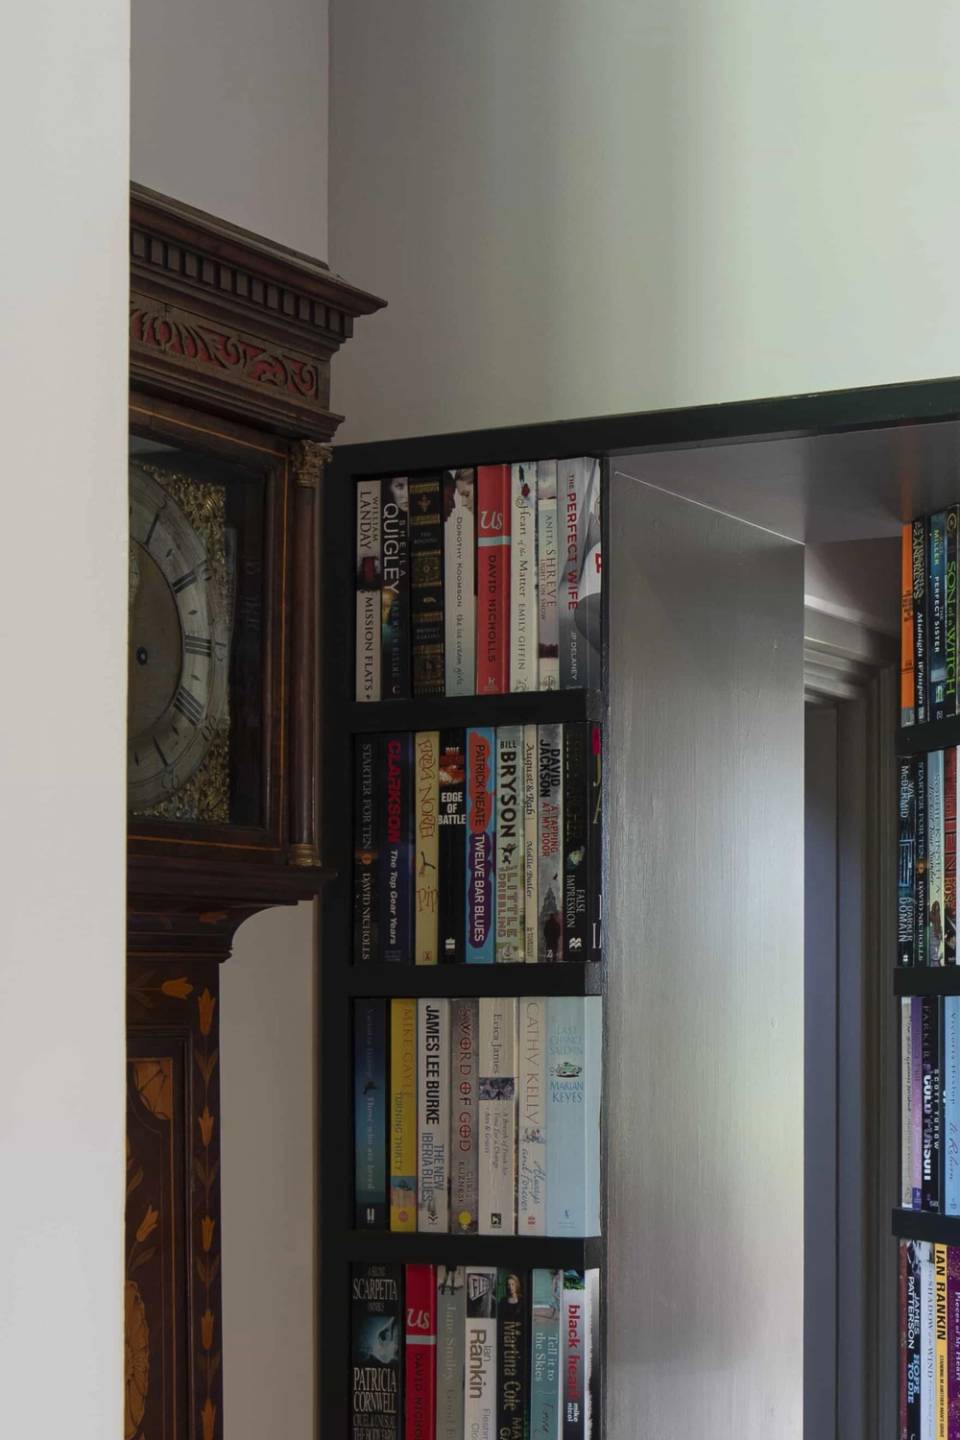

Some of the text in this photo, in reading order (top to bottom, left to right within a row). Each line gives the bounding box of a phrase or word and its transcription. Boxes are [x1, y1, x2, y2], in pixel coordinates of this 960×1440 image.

[360, 492, 370, 549] LANDAY
[384, 503, 399, 593] QUIGLEY
[567, 493, 577, 562] PERFECT
[568, 570, 578, 610] WIFE
[365, 597, 374, 691] MISSION FLATS
[500, 751, 516, 837] BRYSON
[540, 740, 550, 797] JACKSON
[551, 749, 560, 786] DAVID
[475, 835, 484, 941] TWELVE BAR BLUES
[426, 1005, 439, 1124] JAMES LEE BURKE
[568, 1305, 580, 1348] black
[937, 1249, 946, 1340] IAN RANKIN
[470, 1330, 486, 1398] Rankin
